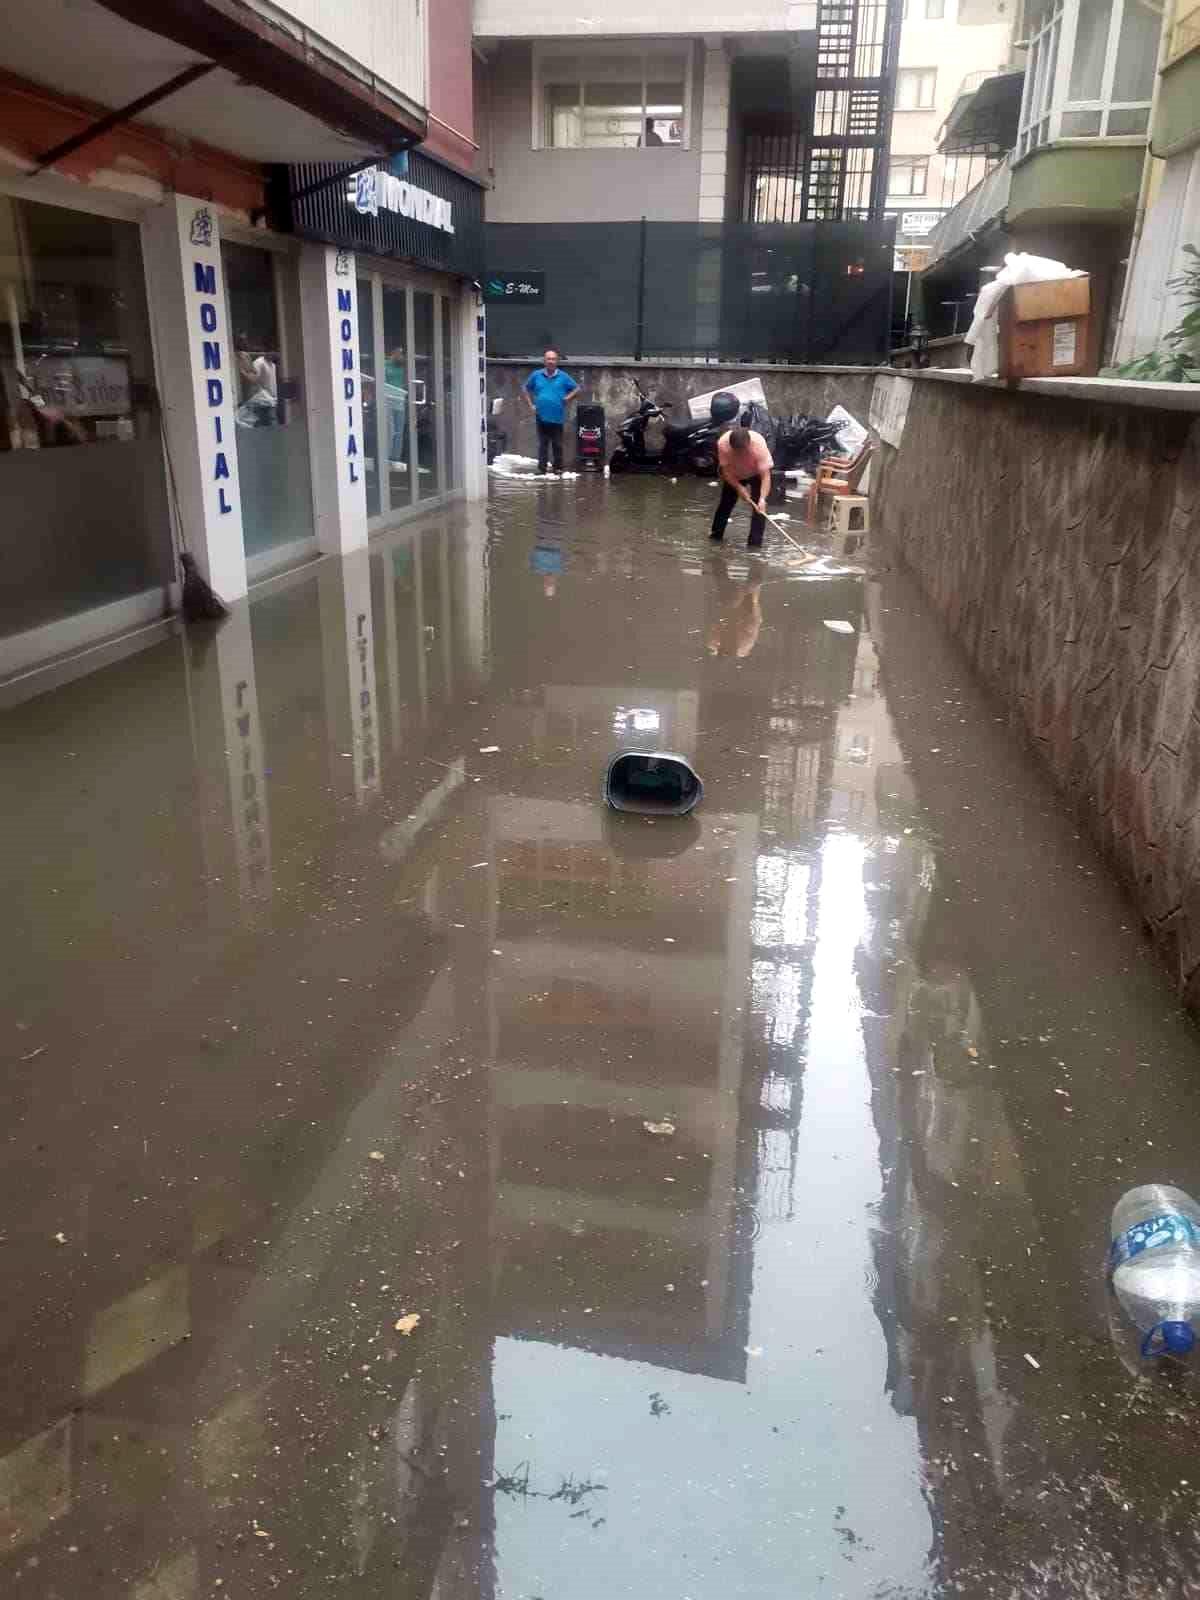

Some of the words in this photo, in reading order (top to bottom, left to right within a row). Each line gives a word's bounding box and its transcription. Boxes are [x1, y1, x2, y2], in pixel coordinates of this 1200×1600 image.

[375, 171, 455, 234] MONDIAL
[193, 262, 232, 514] MONDIAL
[336, 288, 359, 483] MONDIAL
